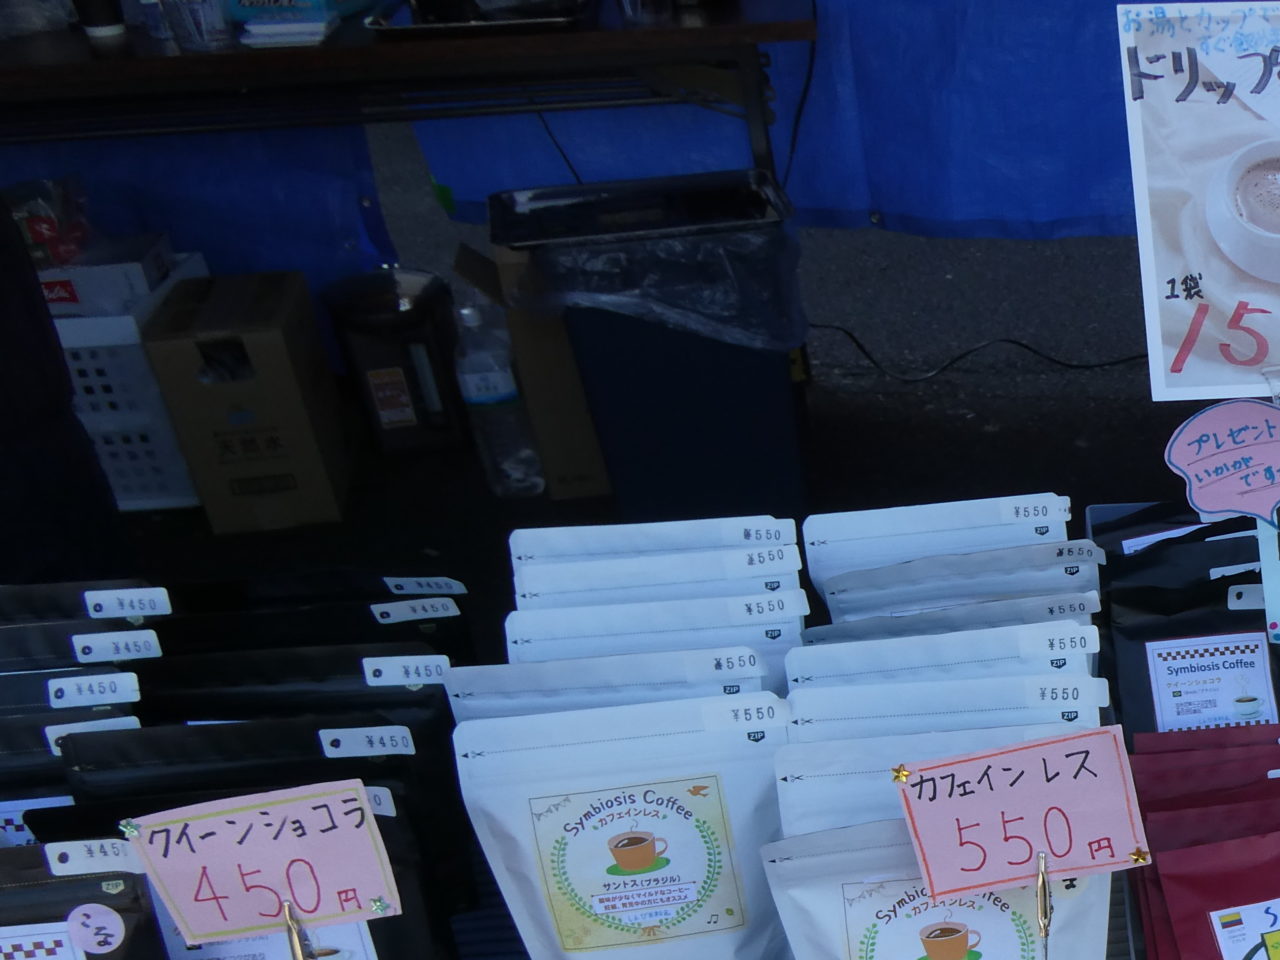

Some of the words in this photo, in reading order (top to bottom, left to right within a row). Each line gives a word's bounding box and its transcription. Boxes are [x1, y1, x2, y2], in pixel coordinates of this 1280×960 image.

[1195, 456, 1252, 483] いかが
[1013, 505, 1049, 519] ¥550
[116, 597, 157, 612] ¥450
[744, 599, 786, 617] ¥550
[1047, 602, 1086, 616] ¥550
[111, 639, 152, 654] ¥450
[1047, 636, 1087, 651] ¥550
[402, 663, 443, 679] ¥450
[1167, 661, 1219, 676] Symbiosis
[1222, 658, 1256, 670] Coffee
[75, 680, 117, 696] ¥450
[1039, 687, 1080, 702] ¥550
[731, 704, 775, 722] ¥550
[365, 734, 409, 750] ¥450
[909, 748, 1099, 802] カフェインレス
[563, 791, 637, 837] Symbiosis
[643, 790, 693, 820] Coffee
[598, 808, 661, 827] カフェインレス
[148, 797, 367, 859] クイーンショコラ
